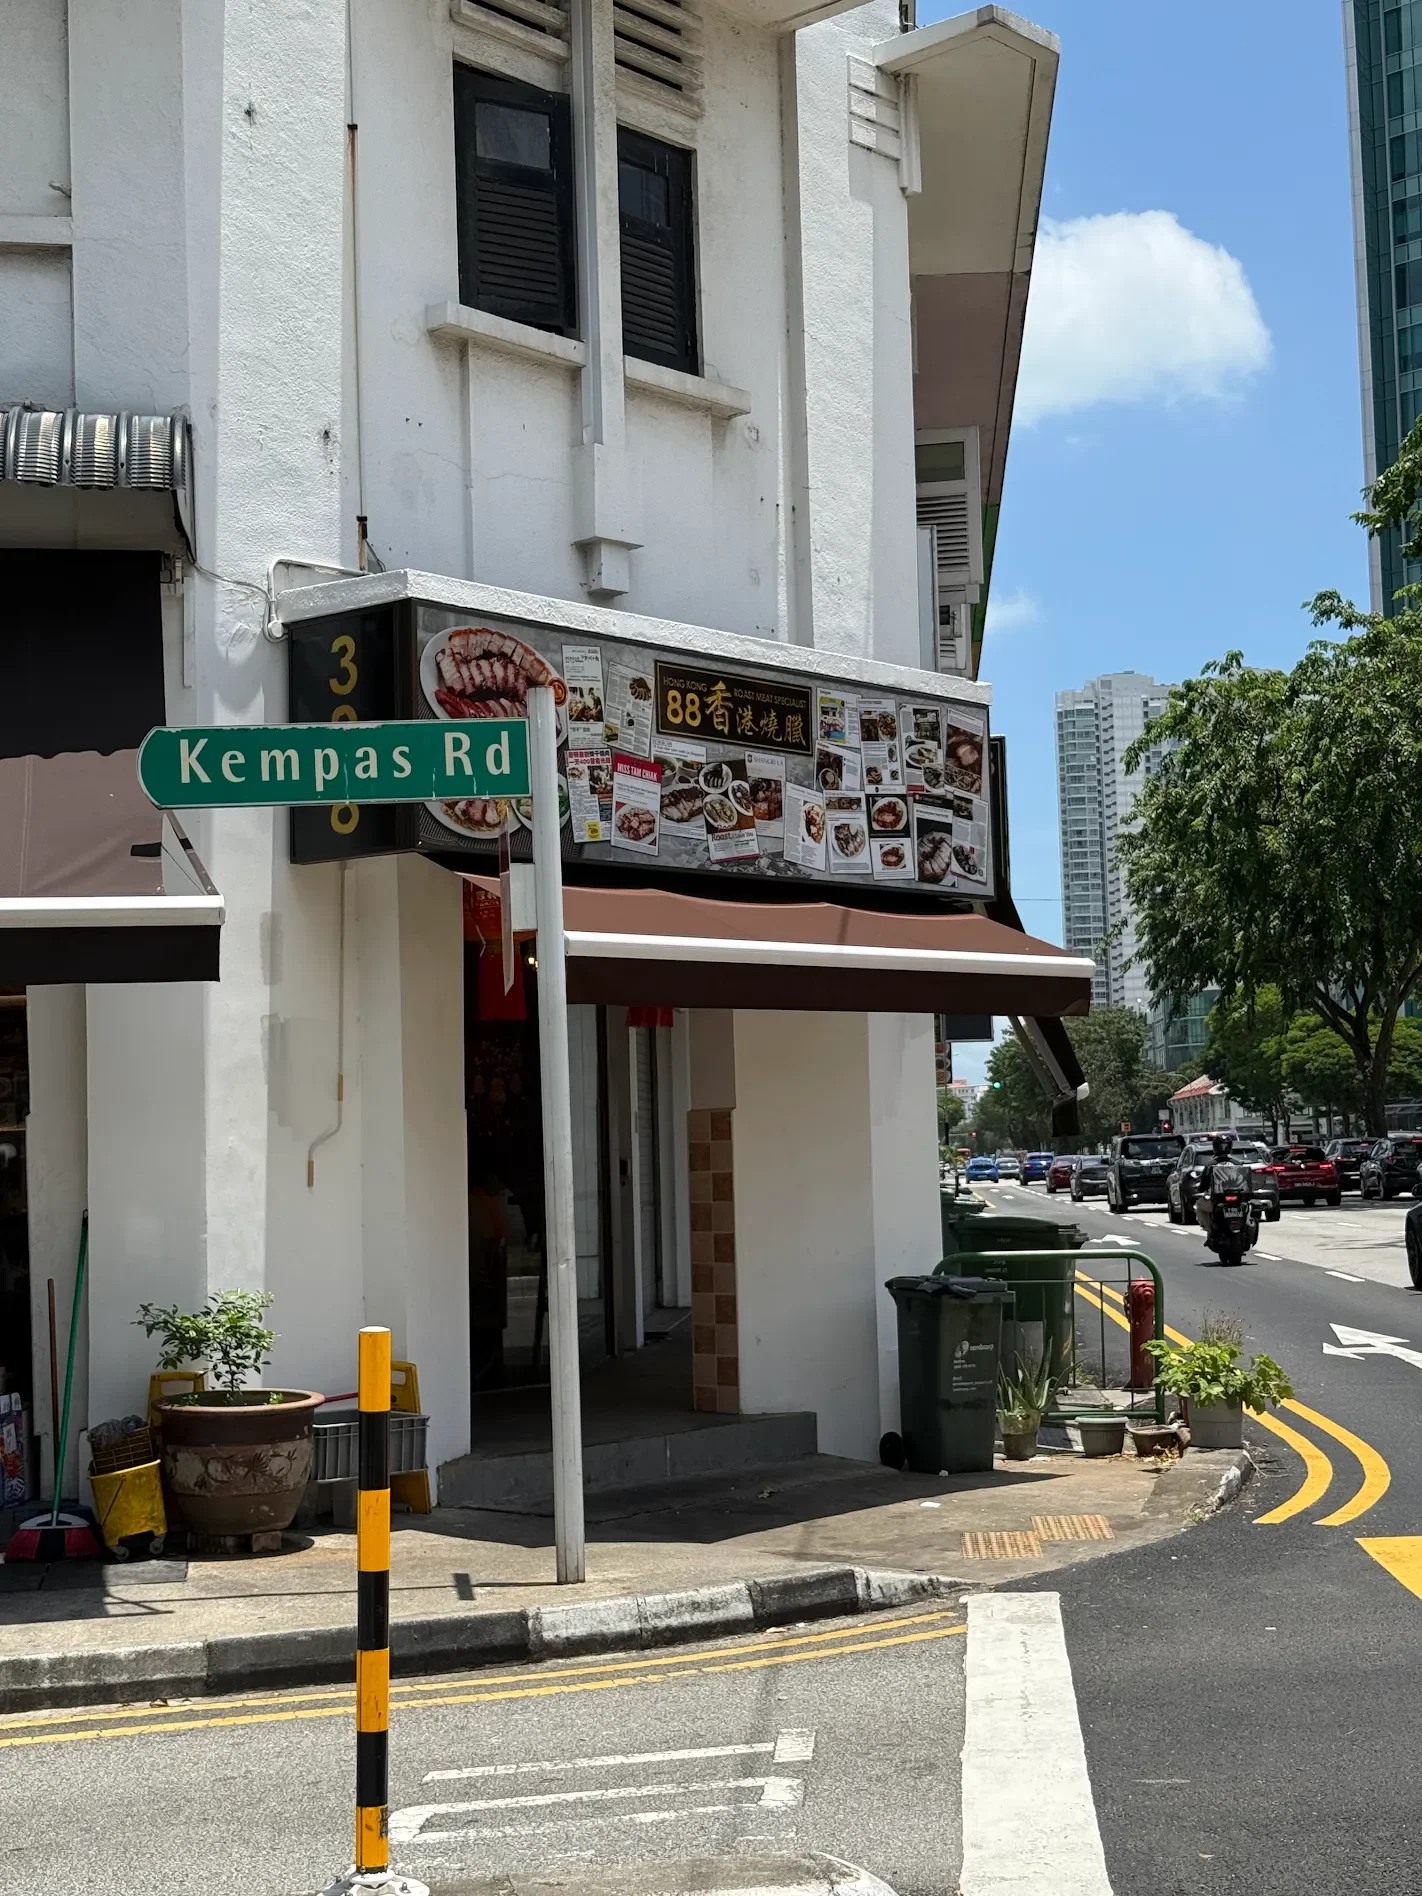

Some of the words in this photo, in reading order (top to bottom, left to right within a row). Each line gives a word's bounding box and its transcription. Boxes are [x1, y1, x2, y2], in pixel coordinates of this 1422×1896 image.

[663, 677, 685, 690] HONG
[686, 680, 708, 692] KONG
[733, 688, 755, 700] ROAST
[755, 691, 773, 704] MEAT
[774, 695, 807, 709] SPECIALIST
[179, 738, 412, 792] Kempas
[444, 730, 511, 777] Rd
[616, 762, 631, 775] MISS
[630, 766, 642, 778] TAM
